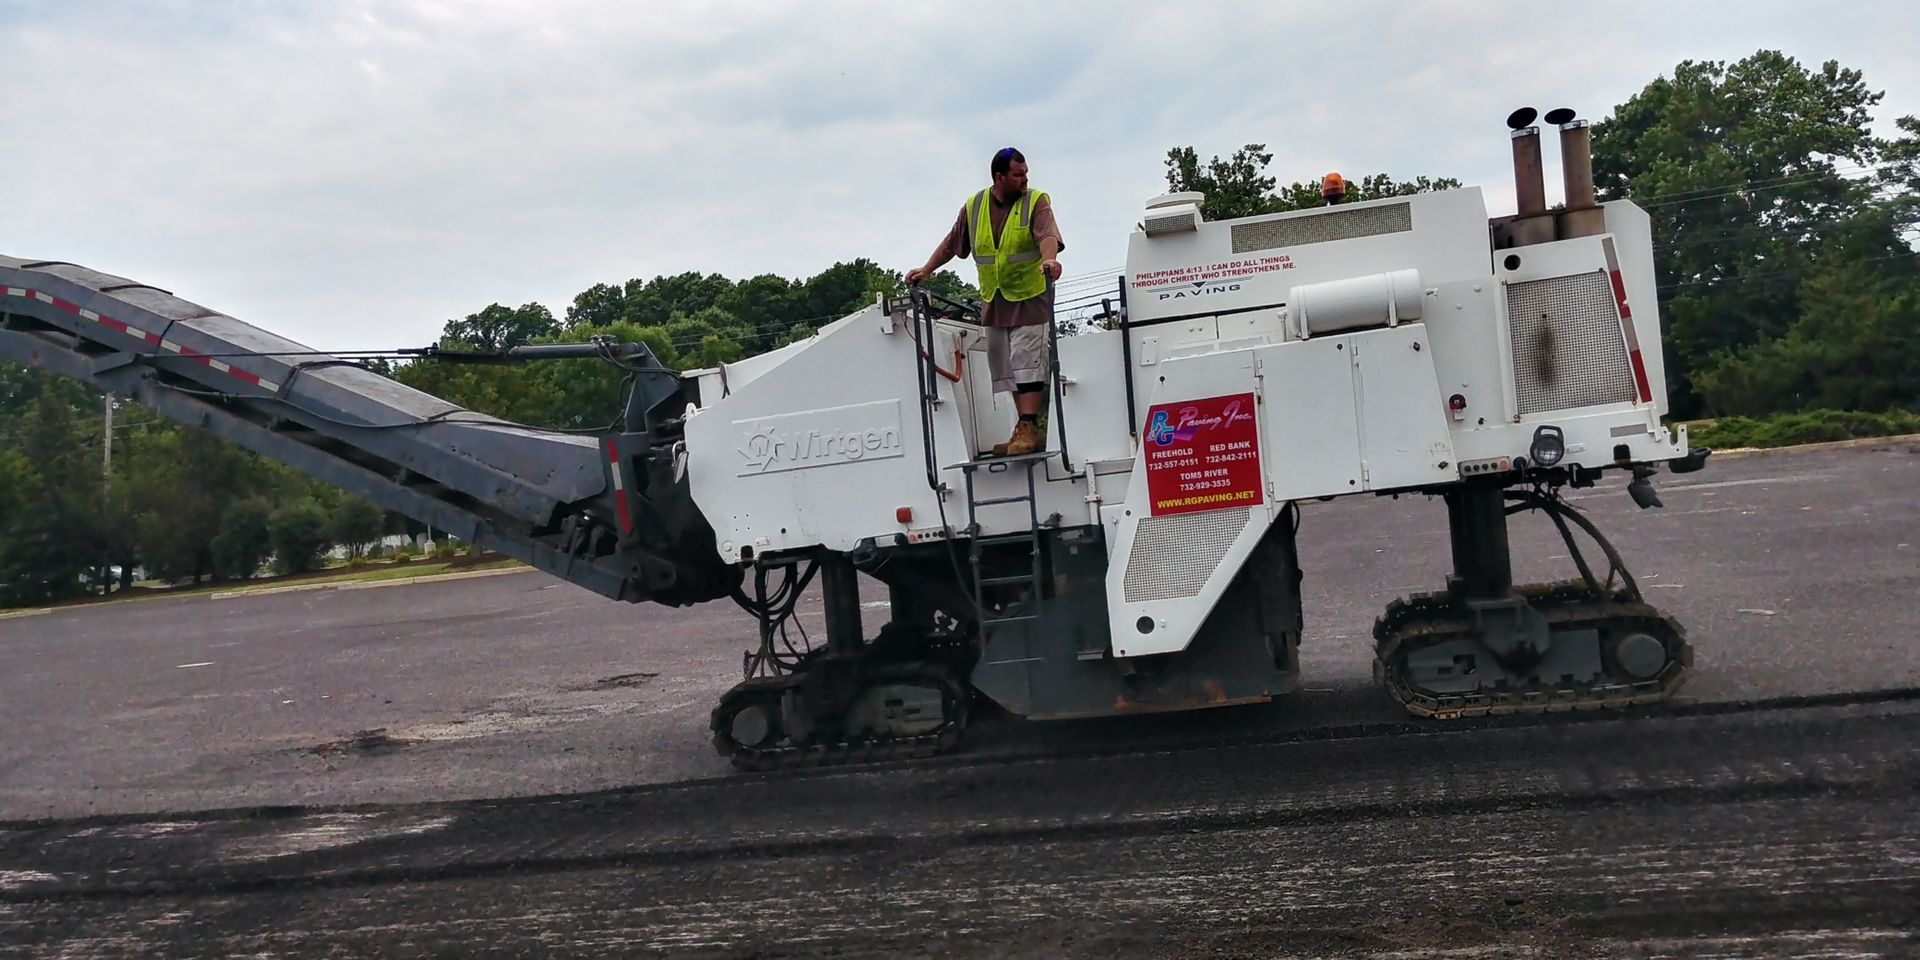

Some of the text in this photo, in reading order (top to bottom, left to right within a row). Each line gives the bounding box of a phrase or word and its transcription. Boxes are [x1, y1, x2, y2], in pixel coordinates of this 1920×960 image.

[1136, 268, 1184, 280] PHILIPPIANS
[1186, 266, 1202, 274] 4:13
[1212, 262, 1228, 271] CAN
[1260, 255, 1290, 265] THINGS
[1131, 262, 1296, 288] THROUGH CHRIST WHO STRENGTHENS ME.
[1160, 284, 1240, 300] PAVING
[1177, 406, 1222, 431] Paving
[1223, 400, 1253, 428] Inc.
[782, 426, 900, 460] Wirtgen
[1210, 441, 1251, 452] RED BANK
[1152, 448, 1193, 459] FREEHOLD
[1205, 451, 1257, 463] 732-842-2111
[1149, 458, 1199, 471] 732-557-0151
[1180, 468, 1228, 480] TOMS RIVER
[1180, 479, 1231, 491] 732-929-3535
[1157, 490, 1256, 509] WWW.RGPAVING.NET
